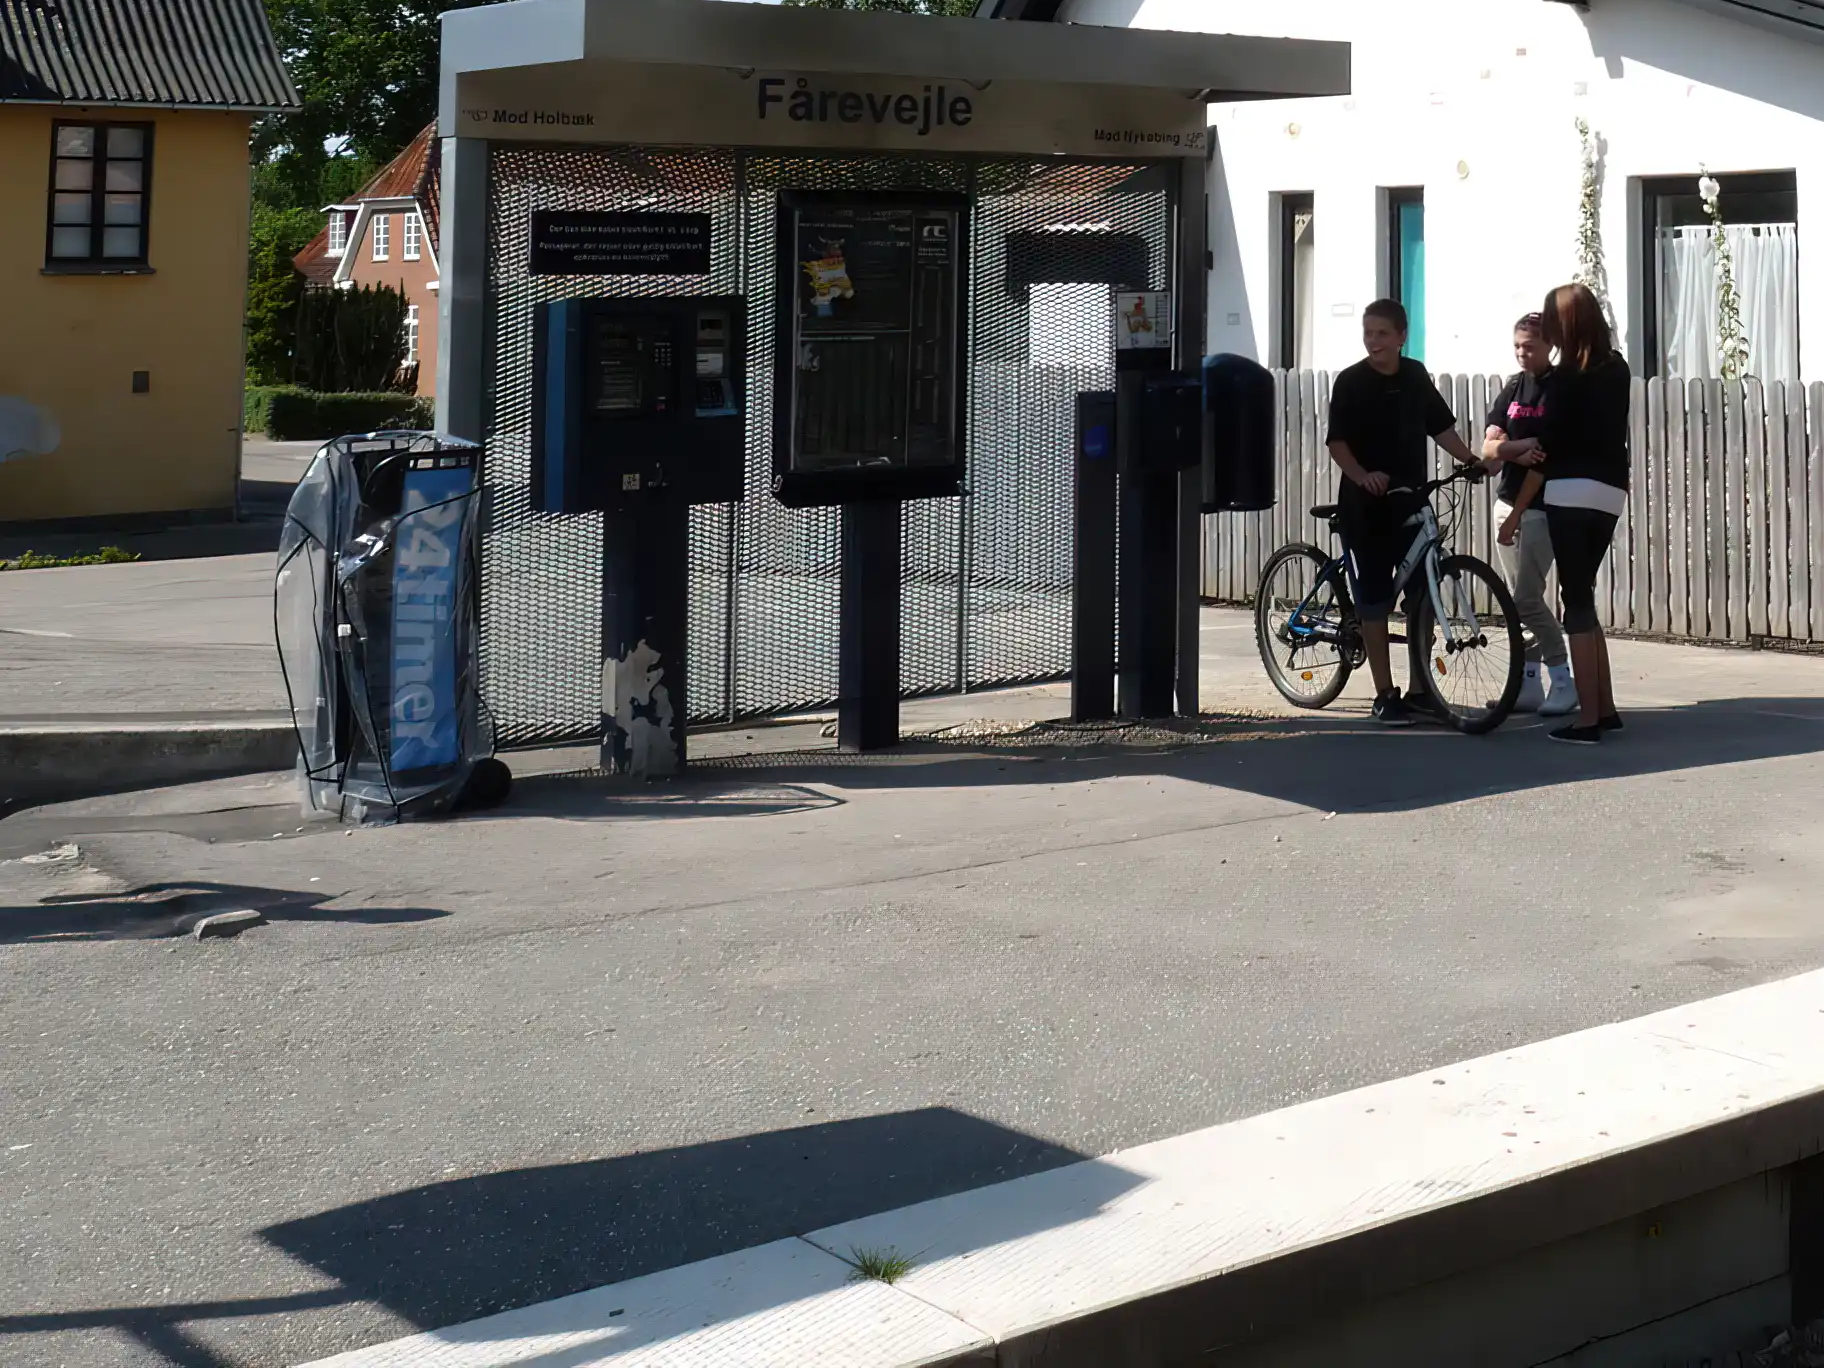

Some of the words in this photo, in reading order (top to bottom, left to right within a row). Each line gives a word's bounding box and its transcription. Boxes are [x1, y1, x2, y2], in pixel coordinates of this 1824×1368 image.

[758, 78, 973, 135] Fårevejle
[492, 109, 528, 124] Mod
[1095, 129, 1120, 142] Mod
